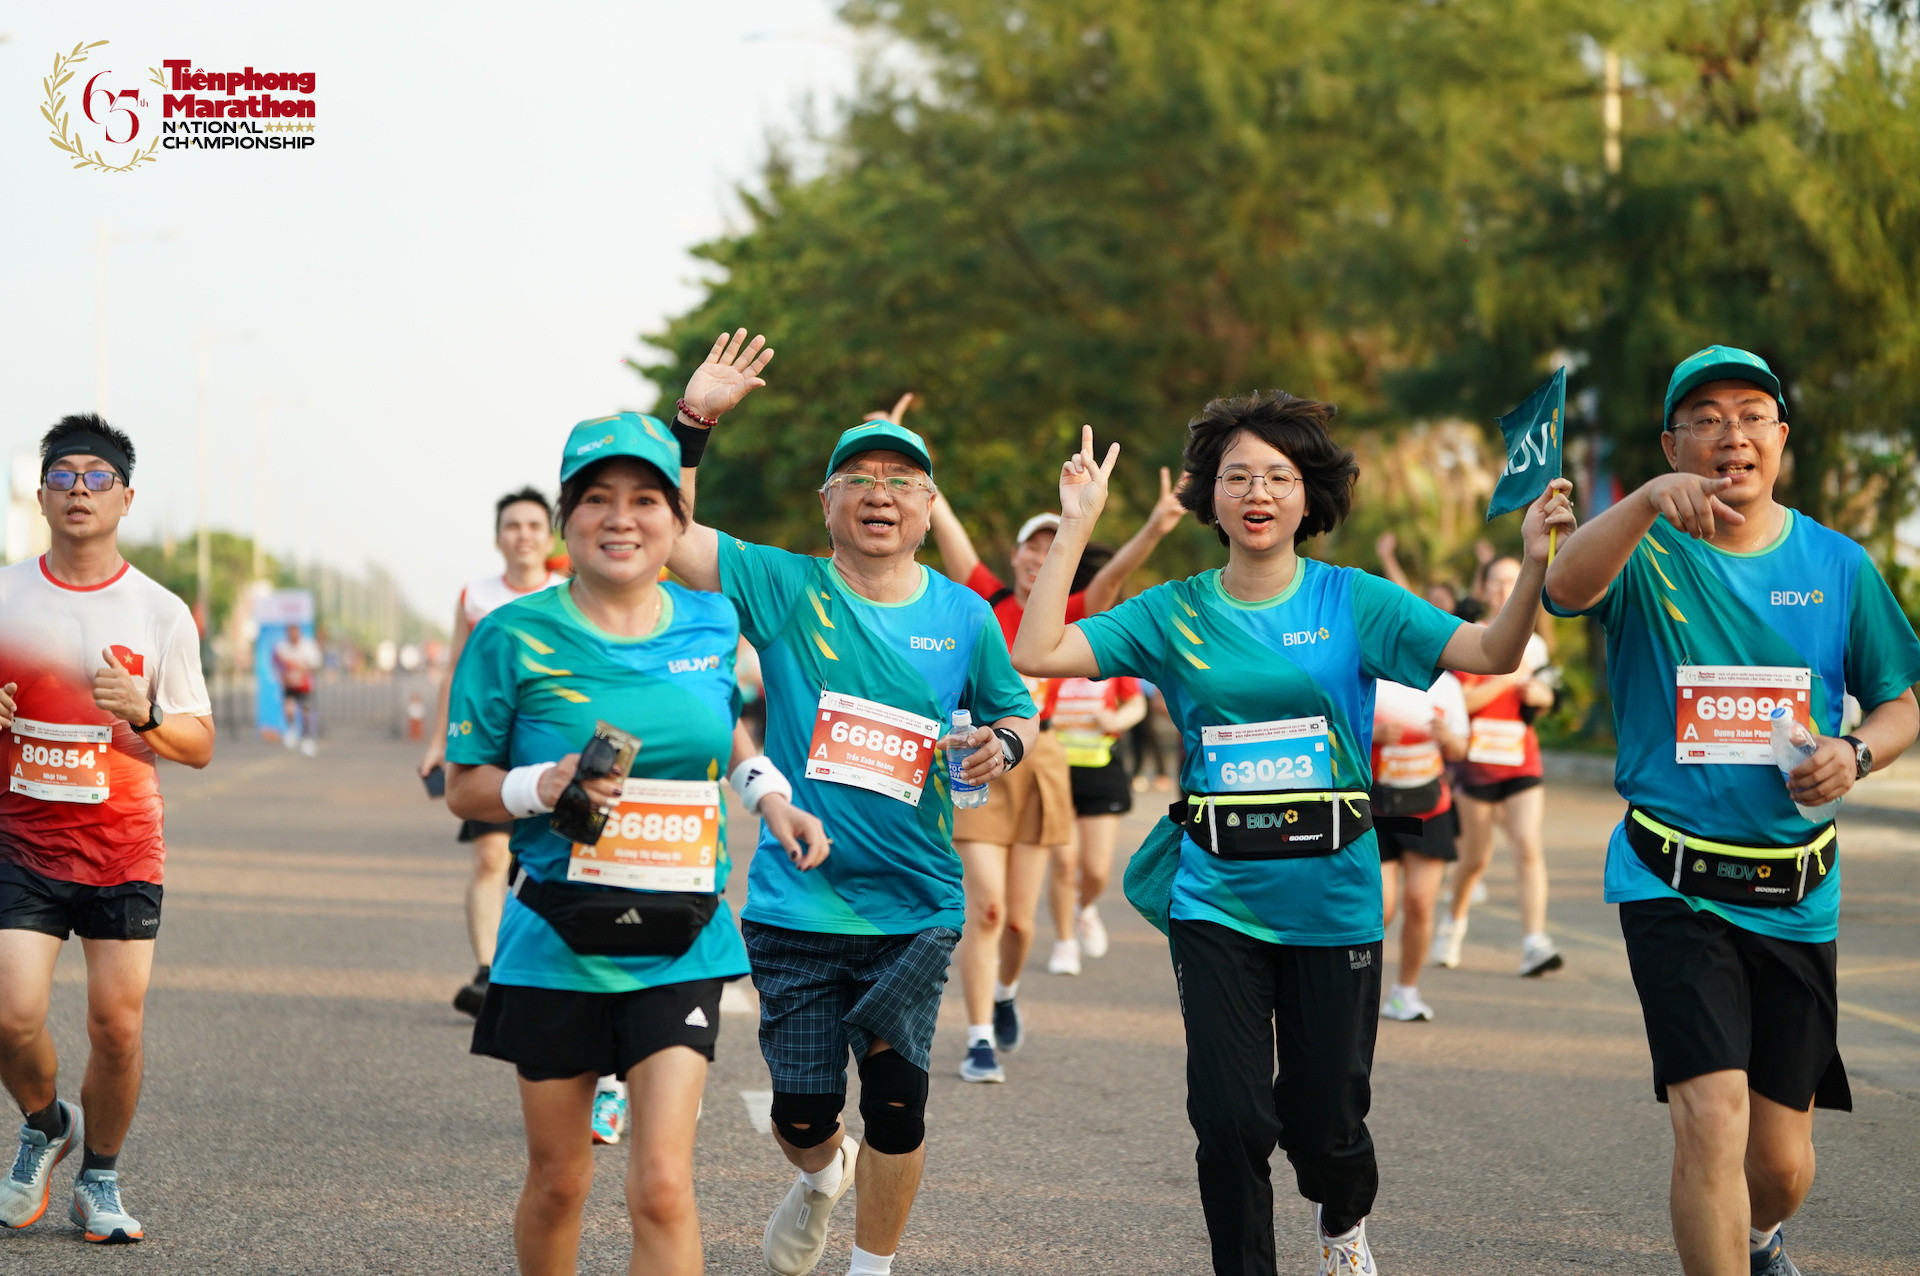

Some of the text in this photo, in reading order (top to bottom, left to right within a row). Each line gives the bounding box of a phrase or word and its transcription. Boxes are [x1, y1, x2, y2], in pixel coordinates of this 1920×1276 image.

[1771, 590, 1811, 606] BIDV
[910, 635, 944, 652] BIDV
[1283, 630, 1319, 647] BIDV
[1683, 723, 1700, 741] A
[831, 721, 920, 762] 66888
[22, 744, 96, 769] 80854
[814, 743, 829, 759] A
[14, 763, 24, 778] A
[912, 768, 925, 784] 5
[1221, 755, 1314, 785] 63023
[96, 772, 106, 786] 3
[1246, 812, 1285, 830] BIDV
[699, 846, 712, 866] 5
[1717, 862, 1757, 880] BIDV
